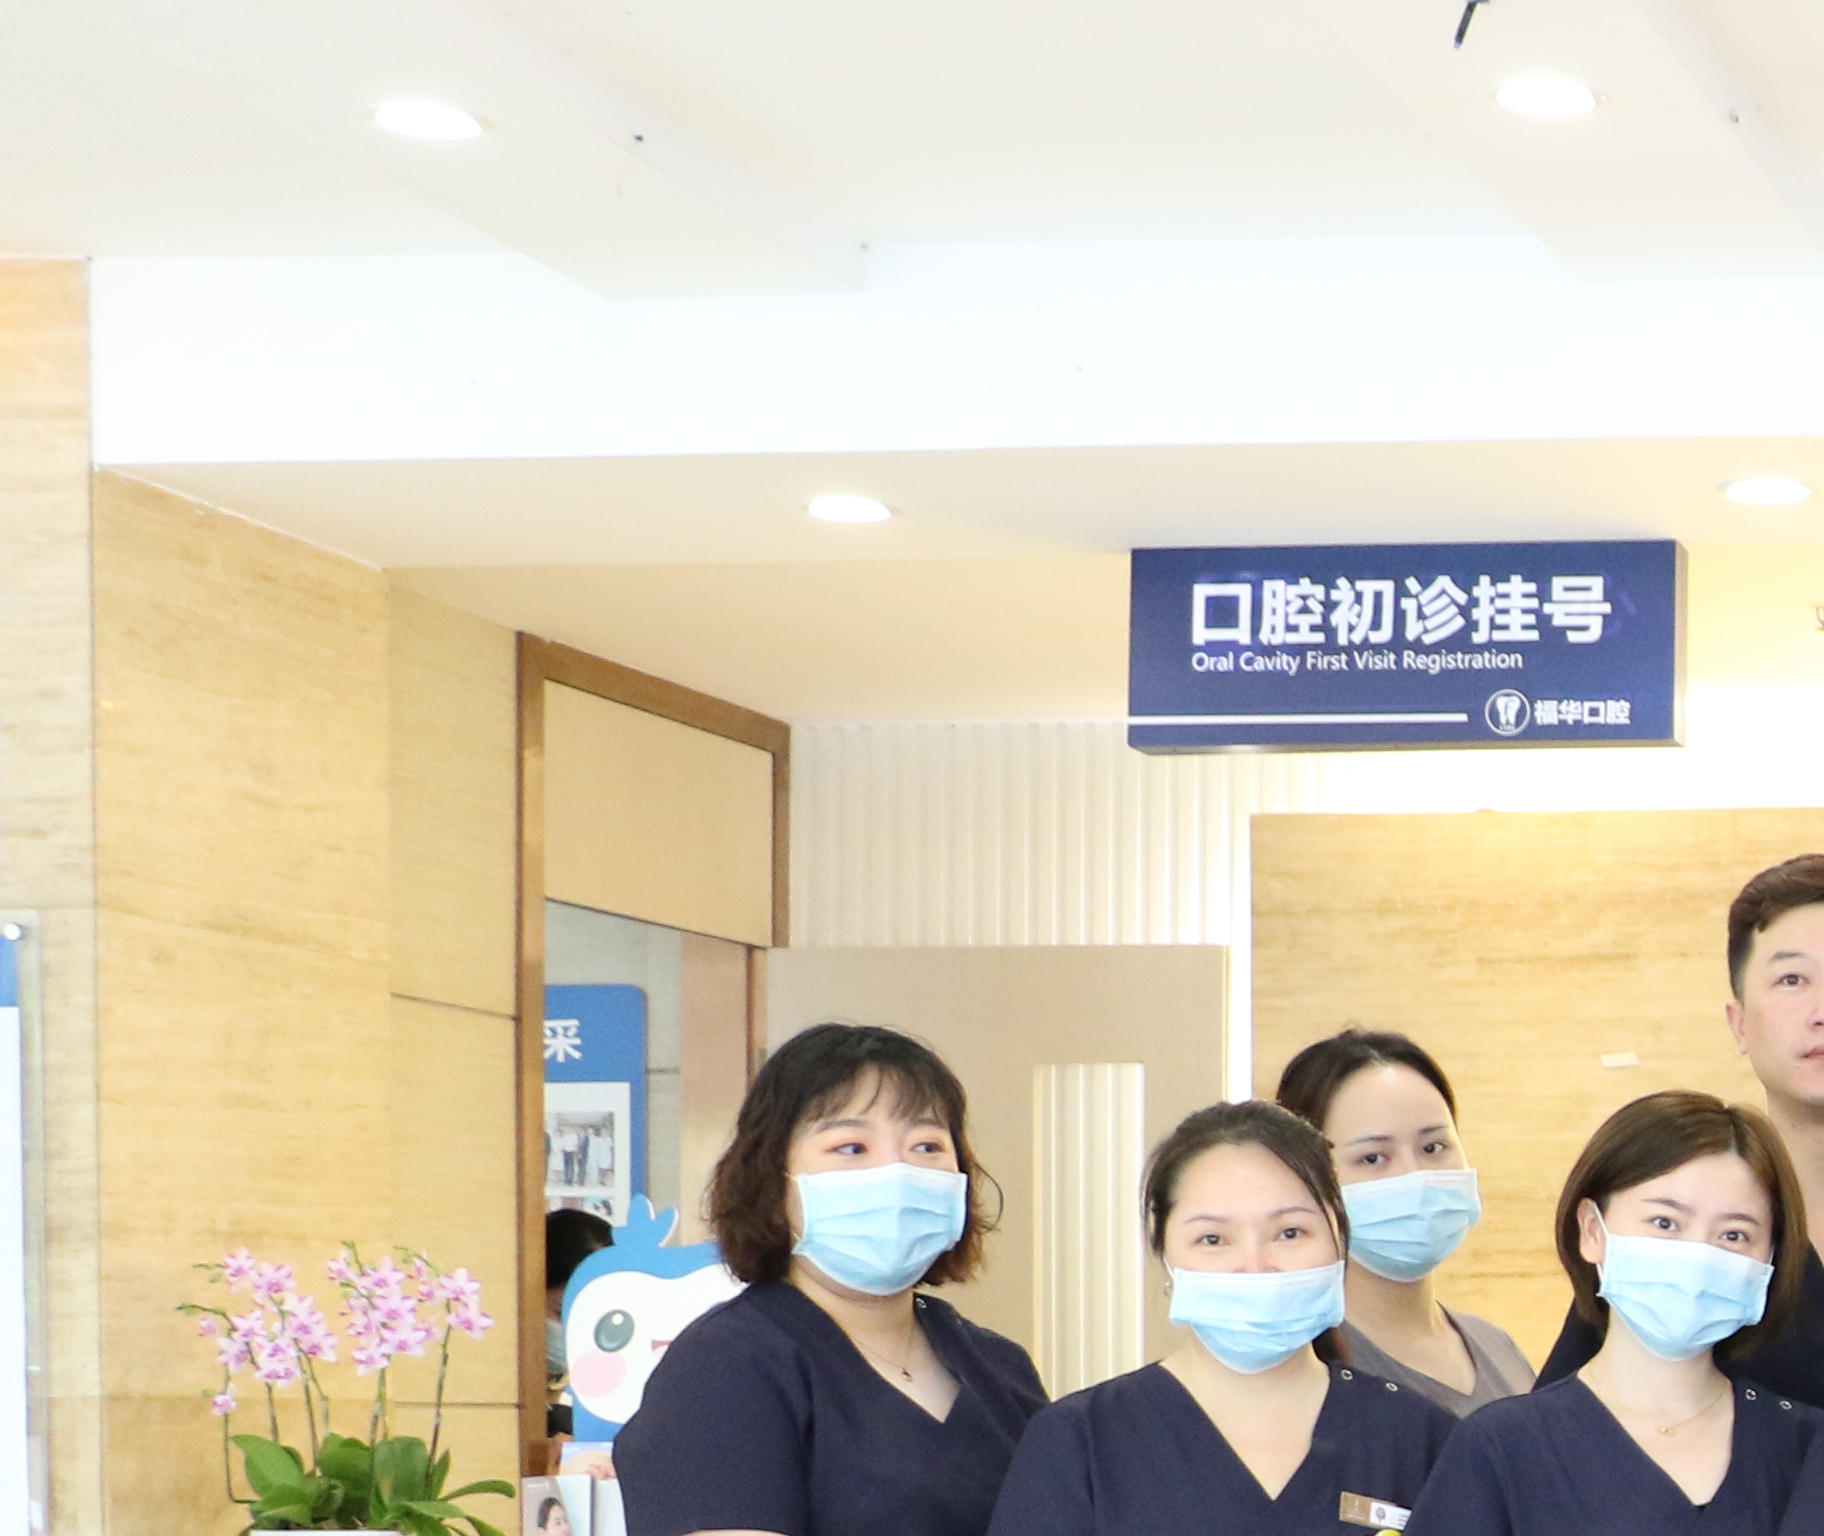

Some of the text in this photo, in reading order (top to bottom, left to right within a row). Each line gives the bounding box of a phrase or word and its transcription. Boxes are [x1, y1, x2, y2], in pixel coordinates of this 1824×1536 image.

[1191, 574, 1612, 647] 口腔初诊挂号
[1192, 648, 1523, 675] Oral Cavity First Visit Registration
[1534, 699, 1631, 725] 福华口腔
